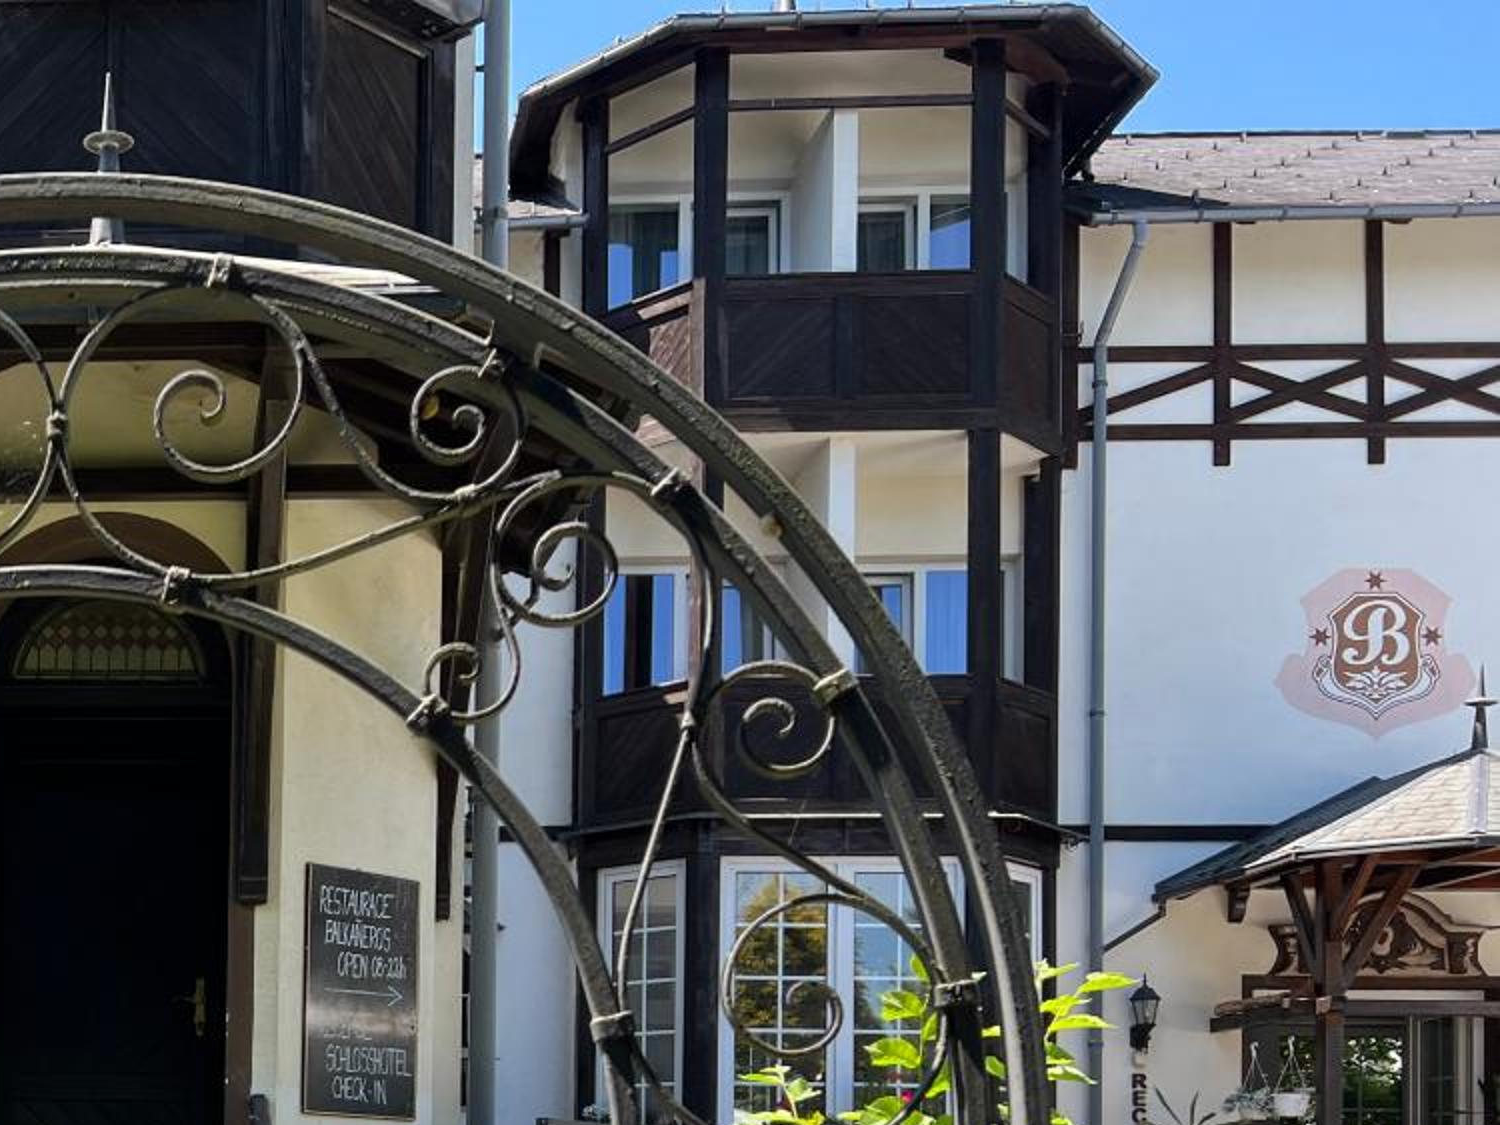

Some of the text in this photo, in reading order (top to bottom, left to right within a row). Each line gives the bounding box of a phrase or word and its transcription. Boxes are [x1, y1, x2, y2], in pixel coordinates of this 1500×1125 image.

[320, 885, 394, 918] RESTAURACE
[337, 952, 368, 979] OPEN
[325, 1044, 412, 1077] SCHLOSSHOTEL
[332, 1075, 387, 1105] CHECK-IN
